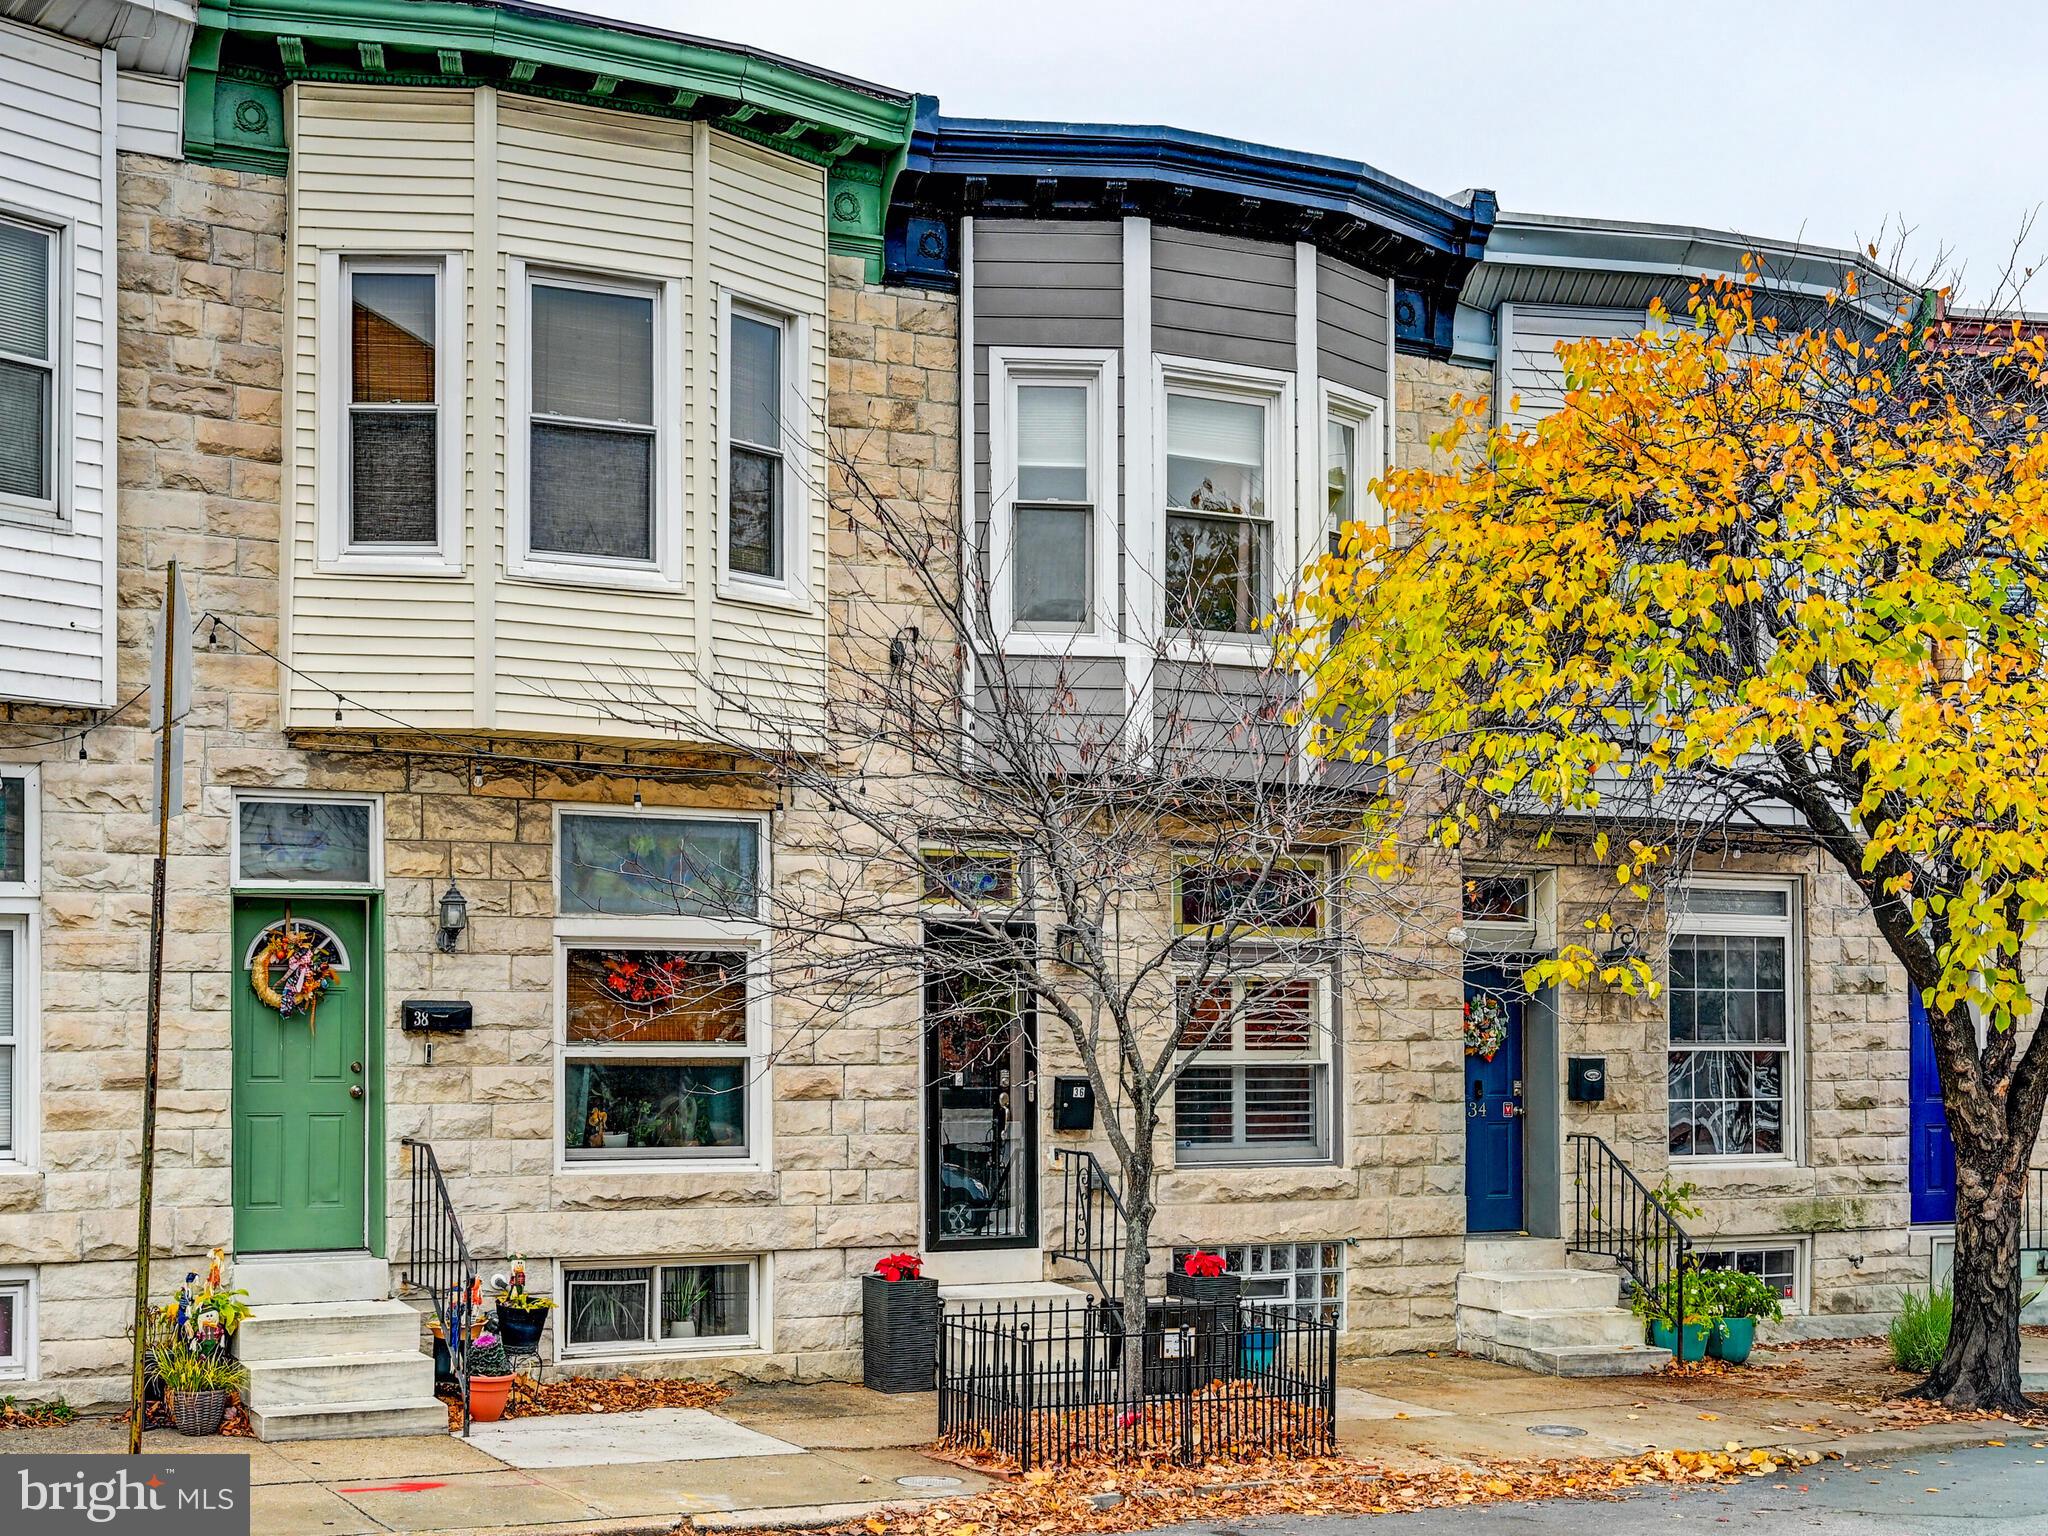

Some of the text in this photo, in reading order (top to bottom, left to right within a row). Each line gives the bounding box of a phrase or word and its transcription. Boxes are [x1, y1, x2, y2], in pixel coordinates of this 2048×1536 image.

[414, 1011, 429, 1026] 38
[1073, 1087, 1085, 1097] 36
[1468, 1102, 1487, 1117] 34
